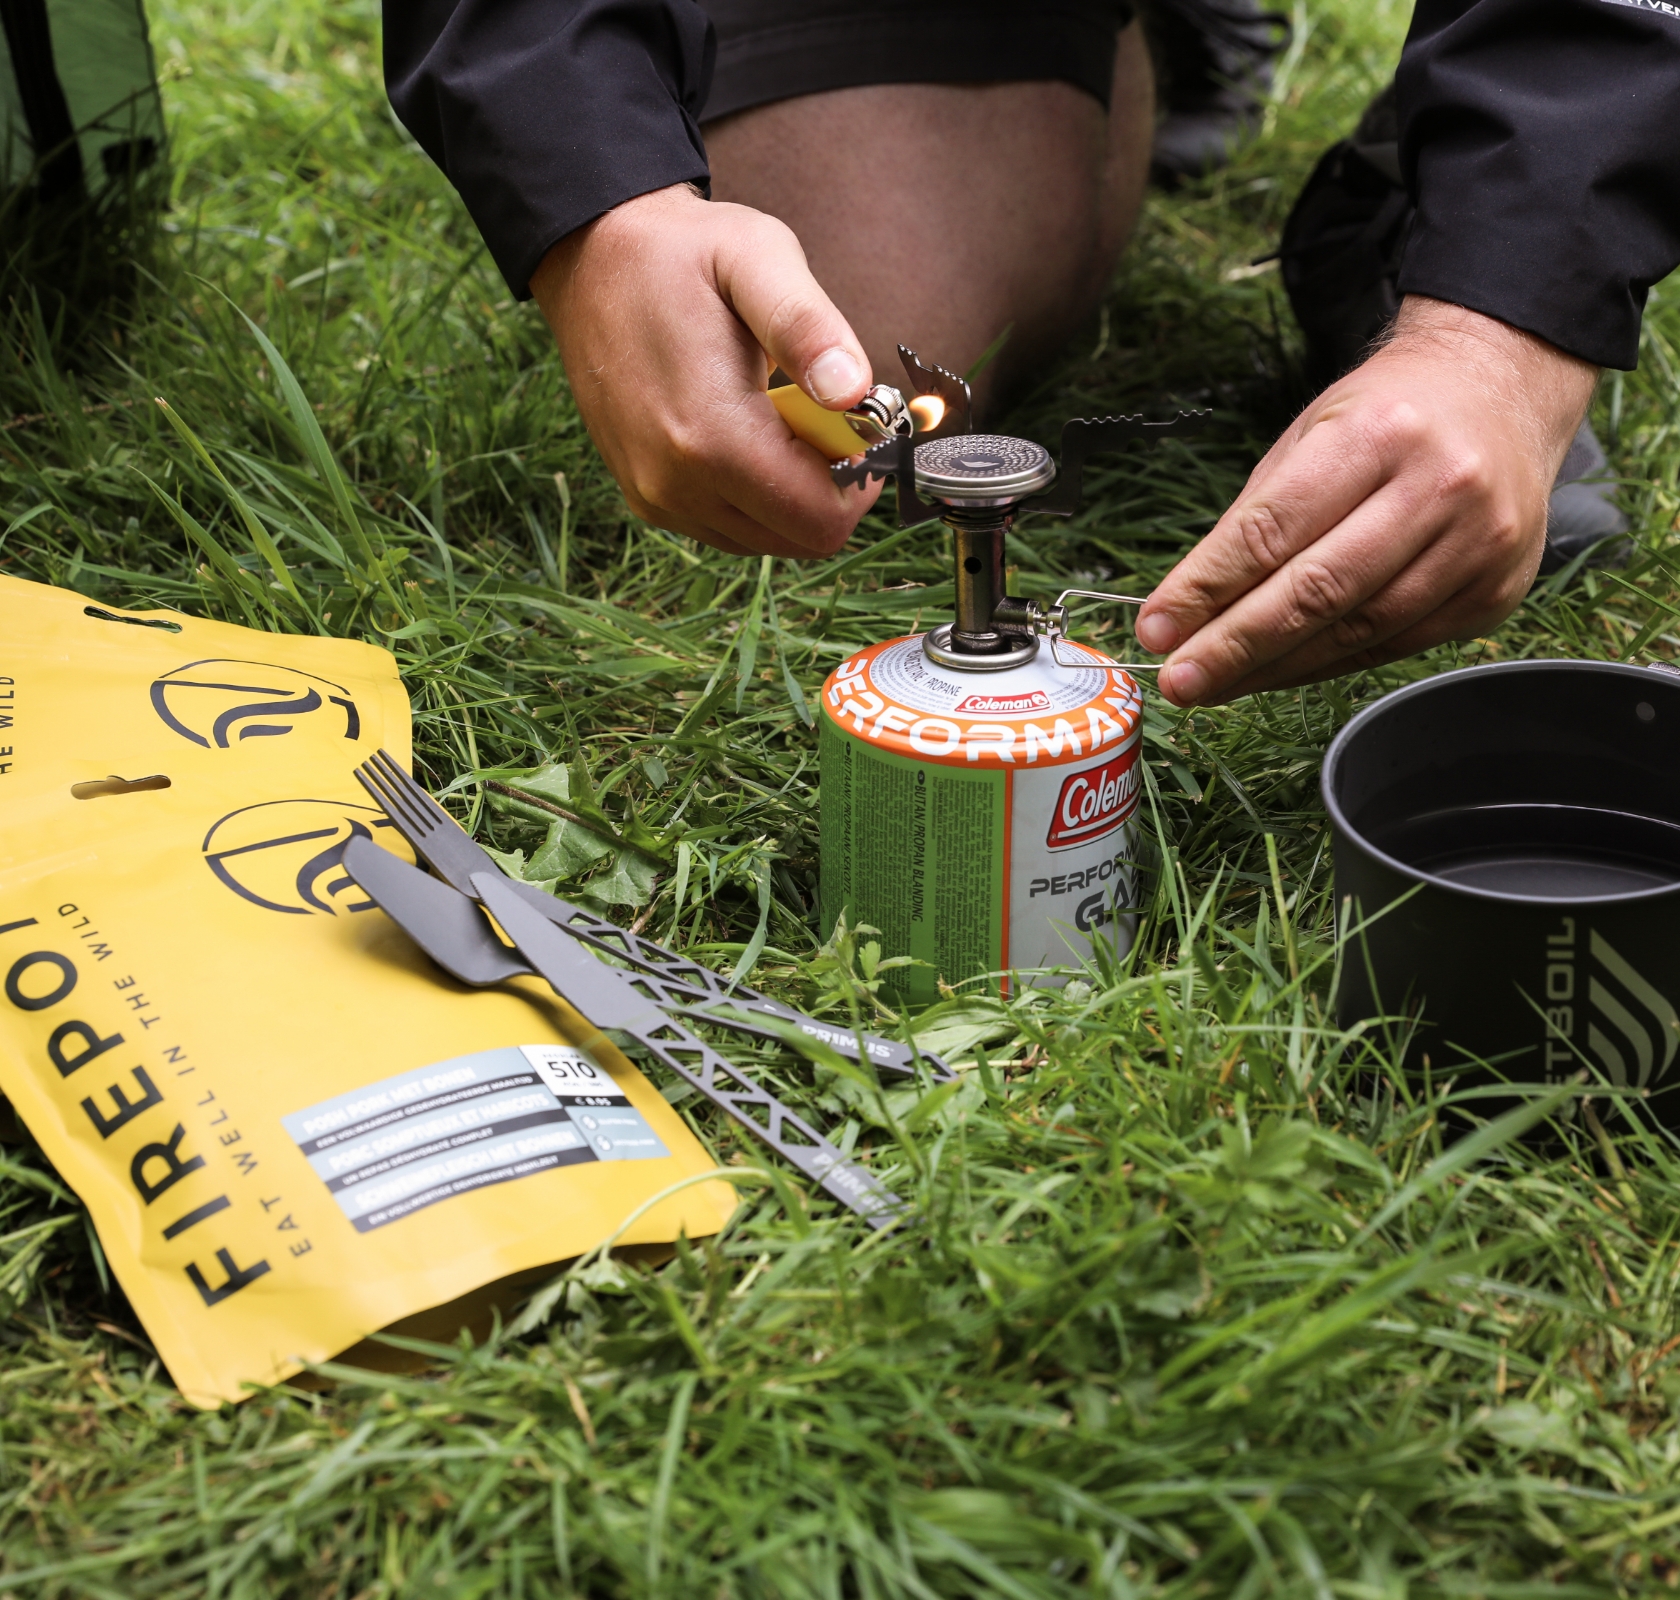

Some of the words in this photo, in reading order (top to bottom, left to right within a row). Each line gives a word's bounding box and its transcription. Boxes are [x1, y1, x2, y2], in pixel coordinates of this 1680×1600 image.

[925, 677, 962, 698] PROPANE
[965, 696, 1034, 711] Coleman
[911, 867, 925, 923] BLANDING
[57, 902, 113, 962] WILD
[113, 974, 161, 1031] THE
[1545, 917, 1575, 1085] TBOIL
[161, 1044, 196, 1077] IN
[547, 1060, 598, 1079] 510
[196, 1089, 259, 1176] WELL
[260, 1195, 312, 1258] EAT
